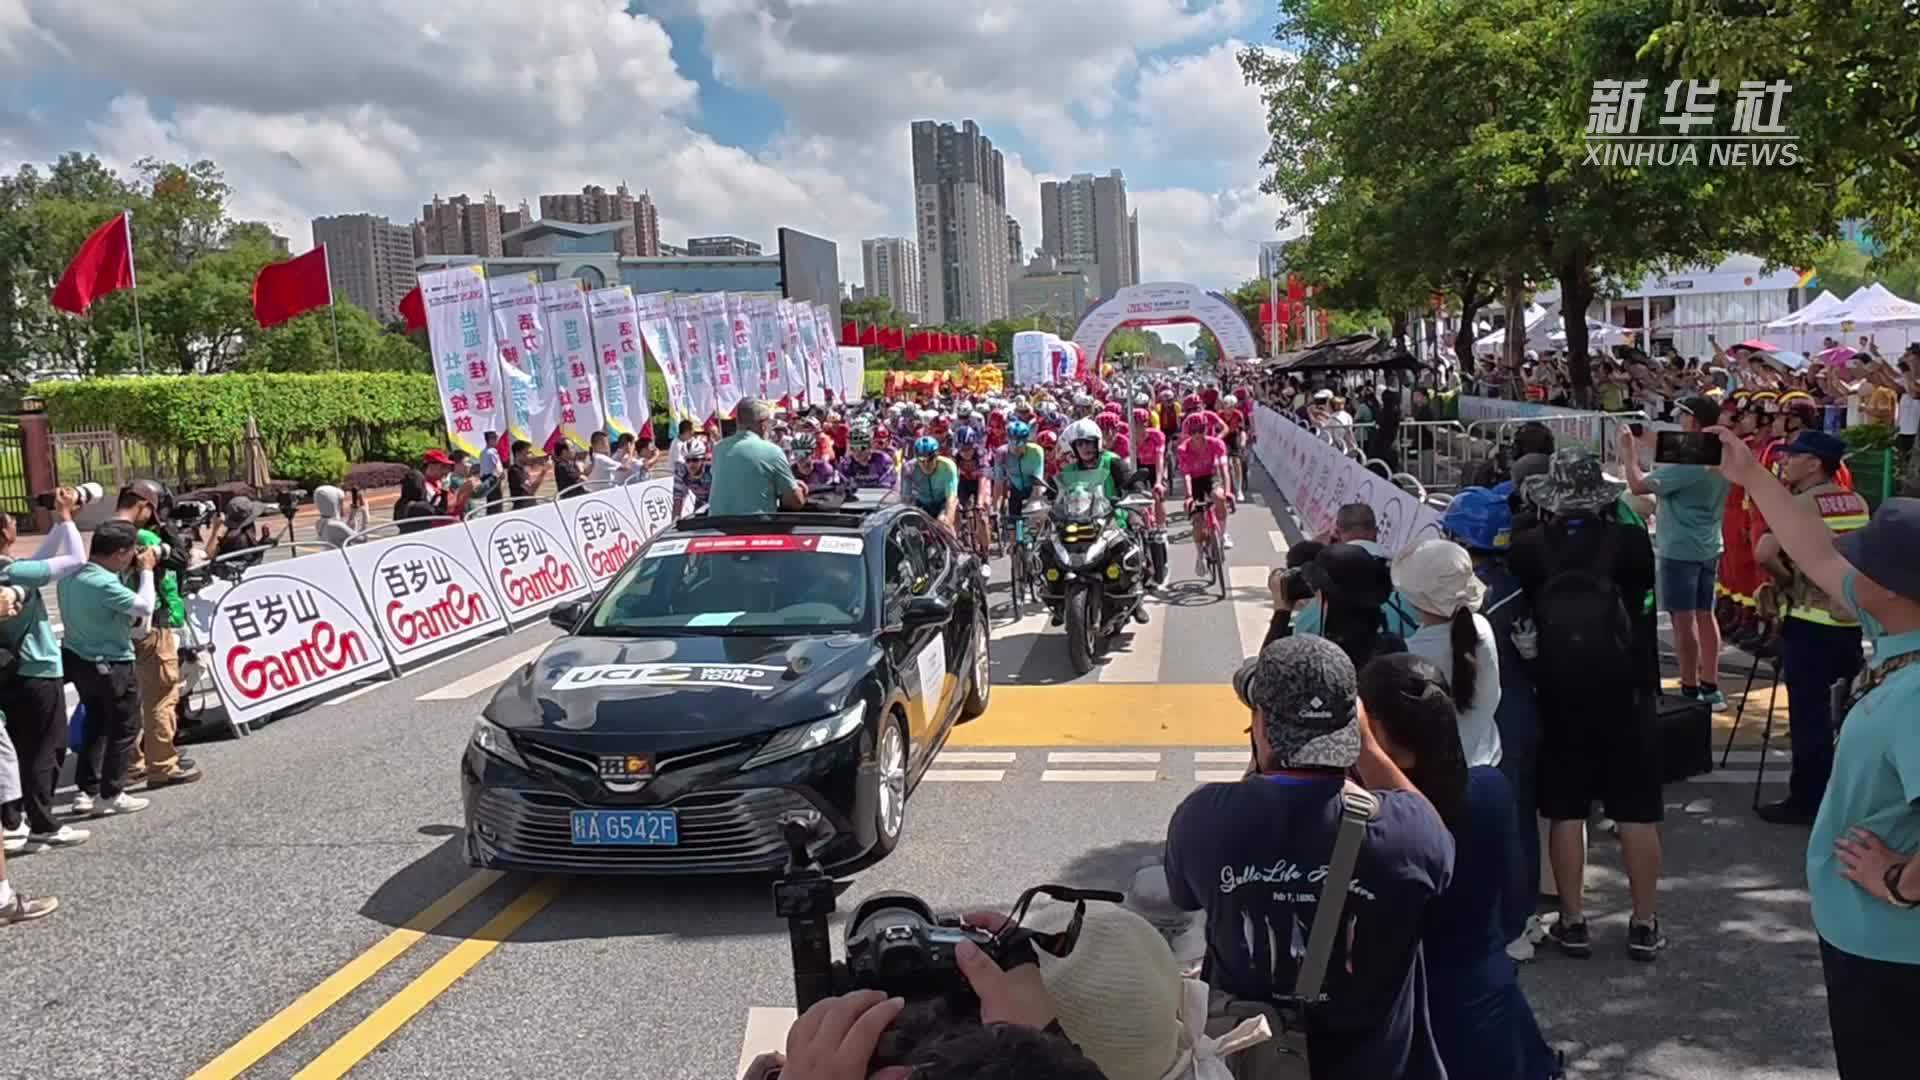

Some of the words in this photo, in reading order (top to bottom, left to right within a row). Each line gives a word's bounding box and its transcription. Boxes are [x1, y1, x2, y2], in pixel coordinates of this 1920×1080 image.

[578, 511, 621, 541] 百岁山
[493, 530, 548, 567] 百岁山
[380, 556, 452, 599] 百岁山
[224, 588, 320, 643] 百岁山
[569, 667, 643, 684] UCI
[702, 667, 766, 678] WORLD
[700, 672, 748, 683] TOUR
[606, 815, 673, 839] G542F
